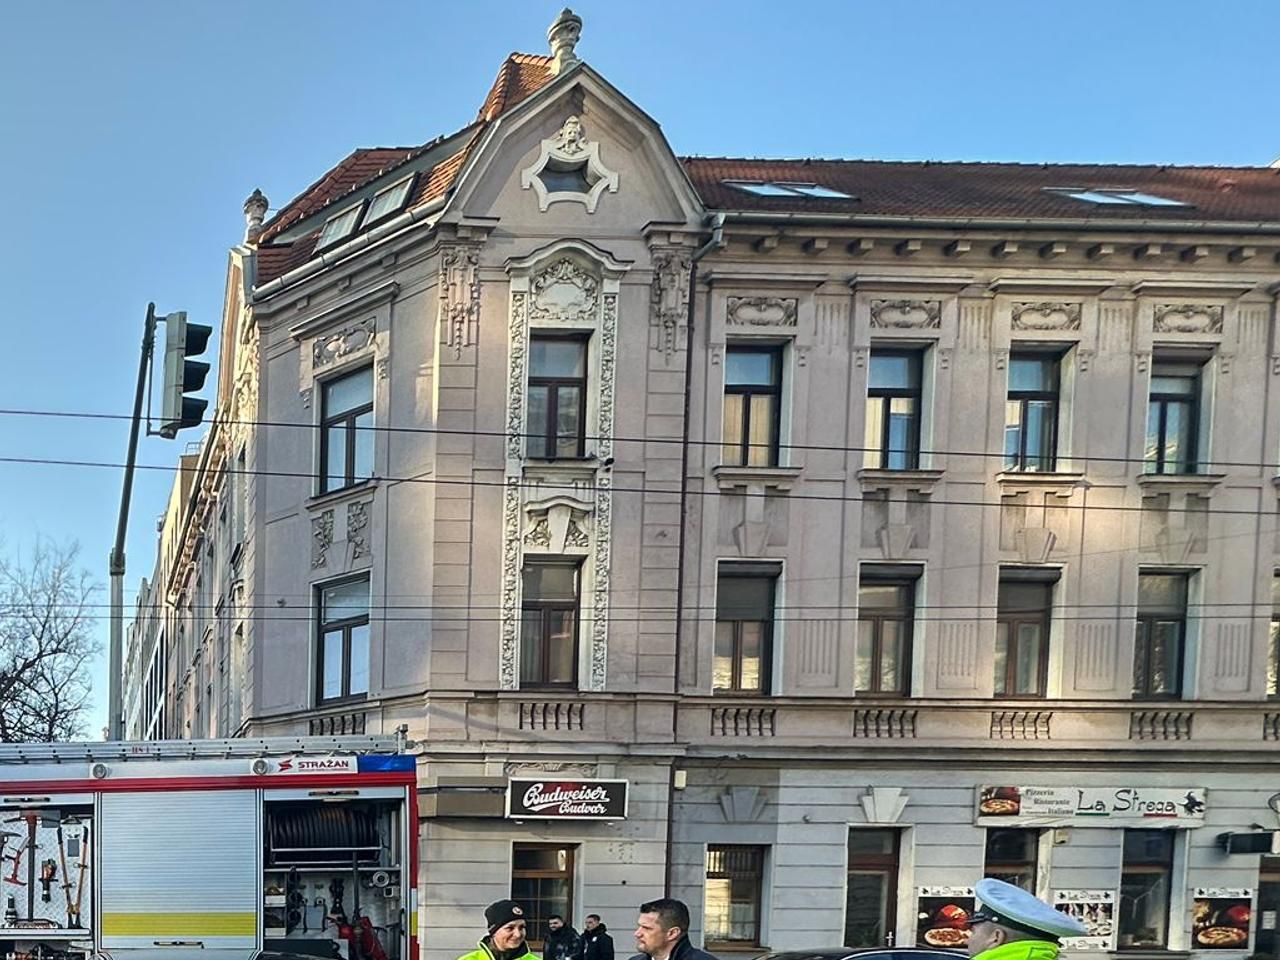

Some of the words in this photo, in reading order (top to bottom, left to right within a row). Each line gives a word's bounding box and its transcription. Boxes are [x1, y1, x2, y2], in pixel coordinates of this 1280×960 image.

[298, 760, 349, 768] STRAŽAN
[523, 783, 608, 807] Budweiser
[1077, 790, 1106, 811] La
[1113, 789, 1176, 813] Strega
[559, 800, 607, 814] Budvar
